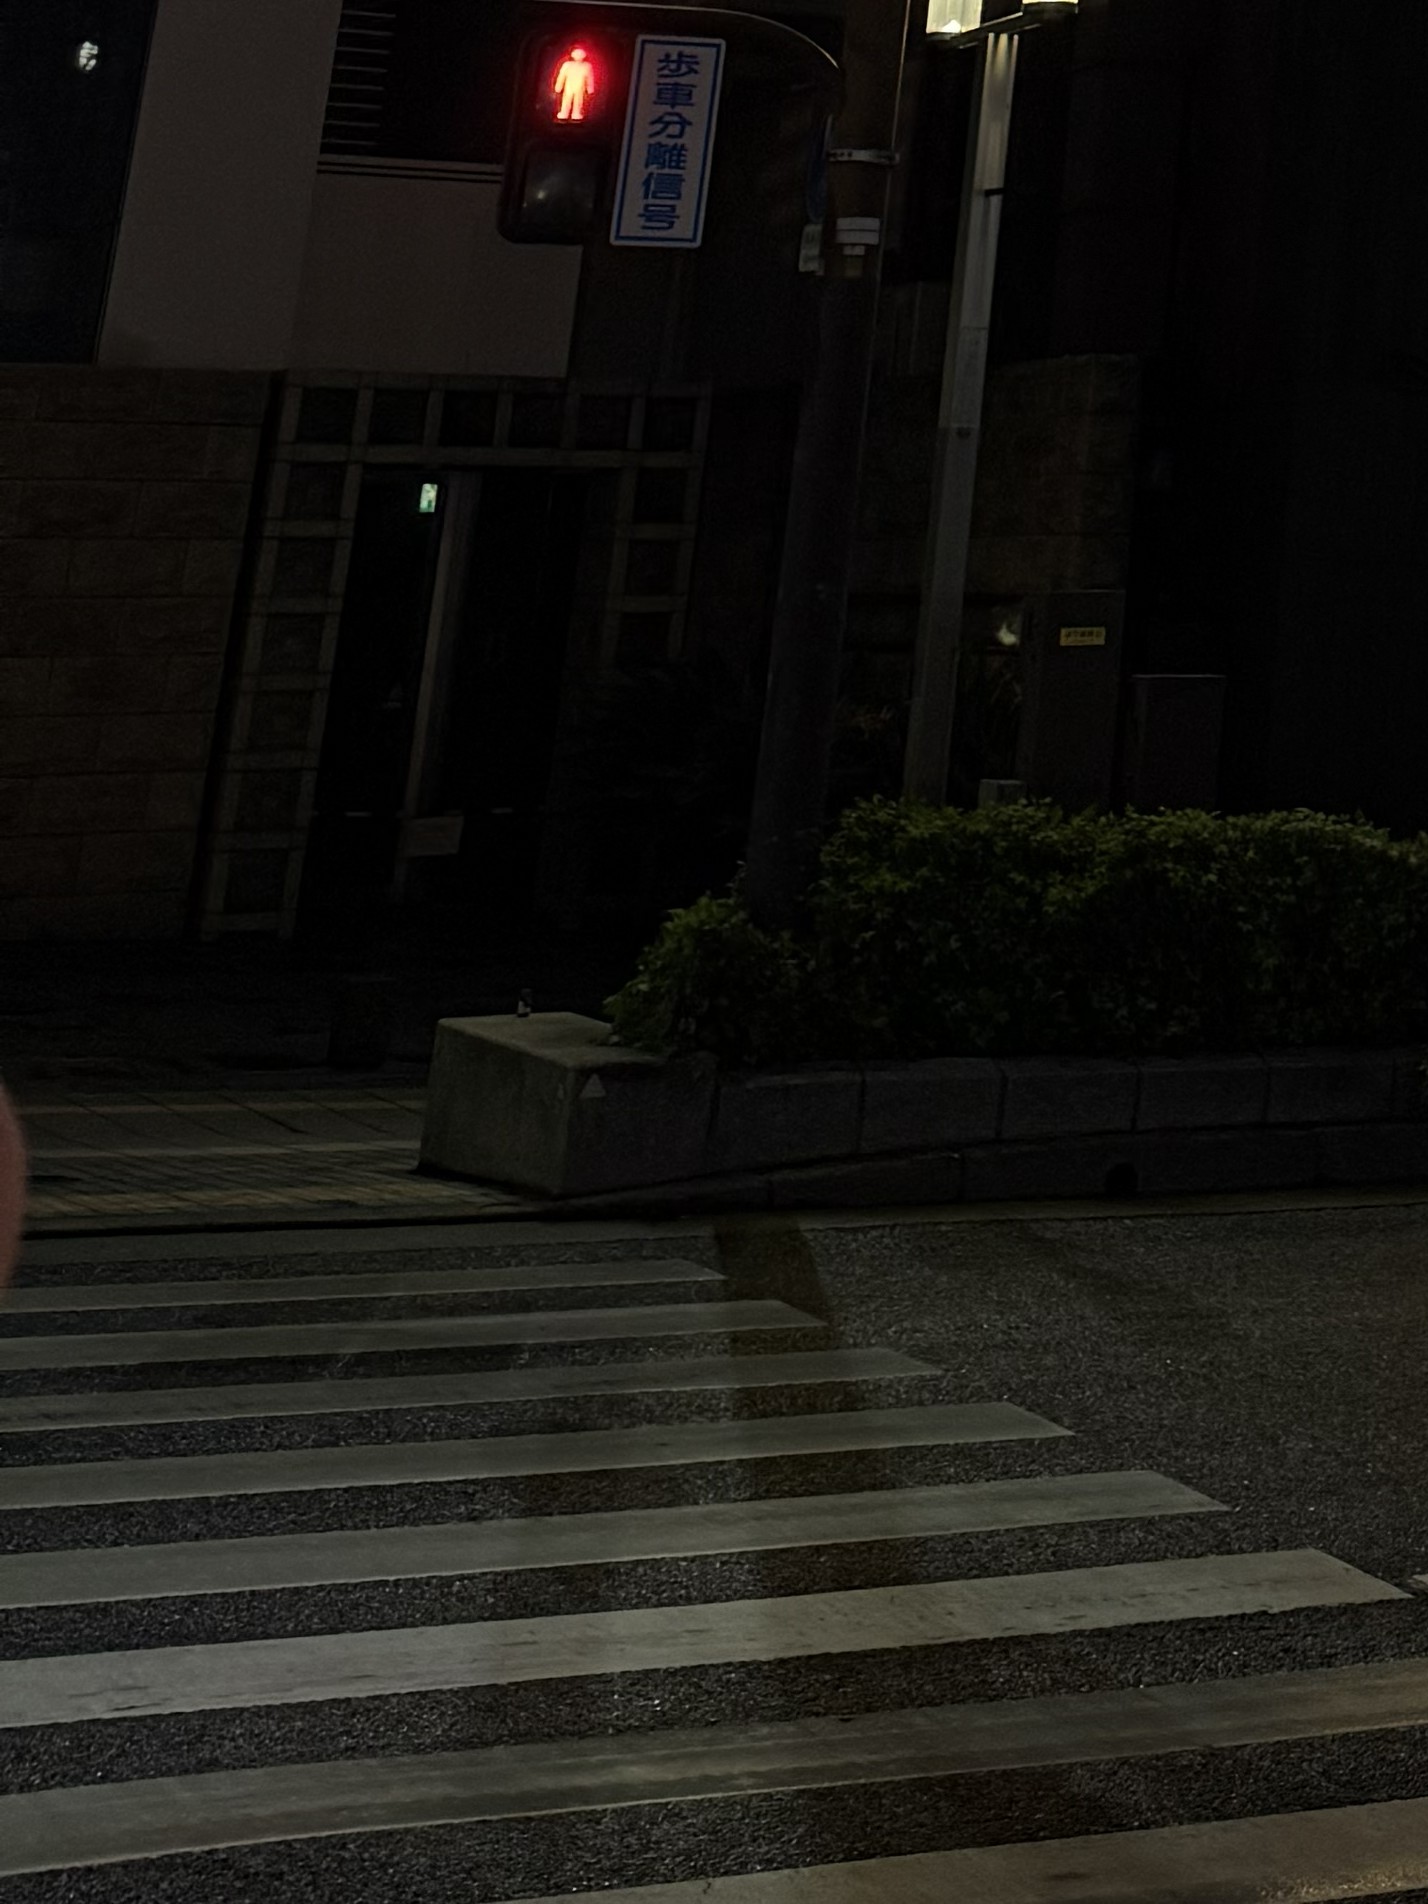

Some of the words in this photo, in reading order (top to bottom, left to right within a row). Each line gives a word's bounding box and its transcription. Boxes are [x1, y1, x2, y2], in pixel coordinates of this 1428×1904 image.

[636, 48, 702, 233] 歩車分離信号
